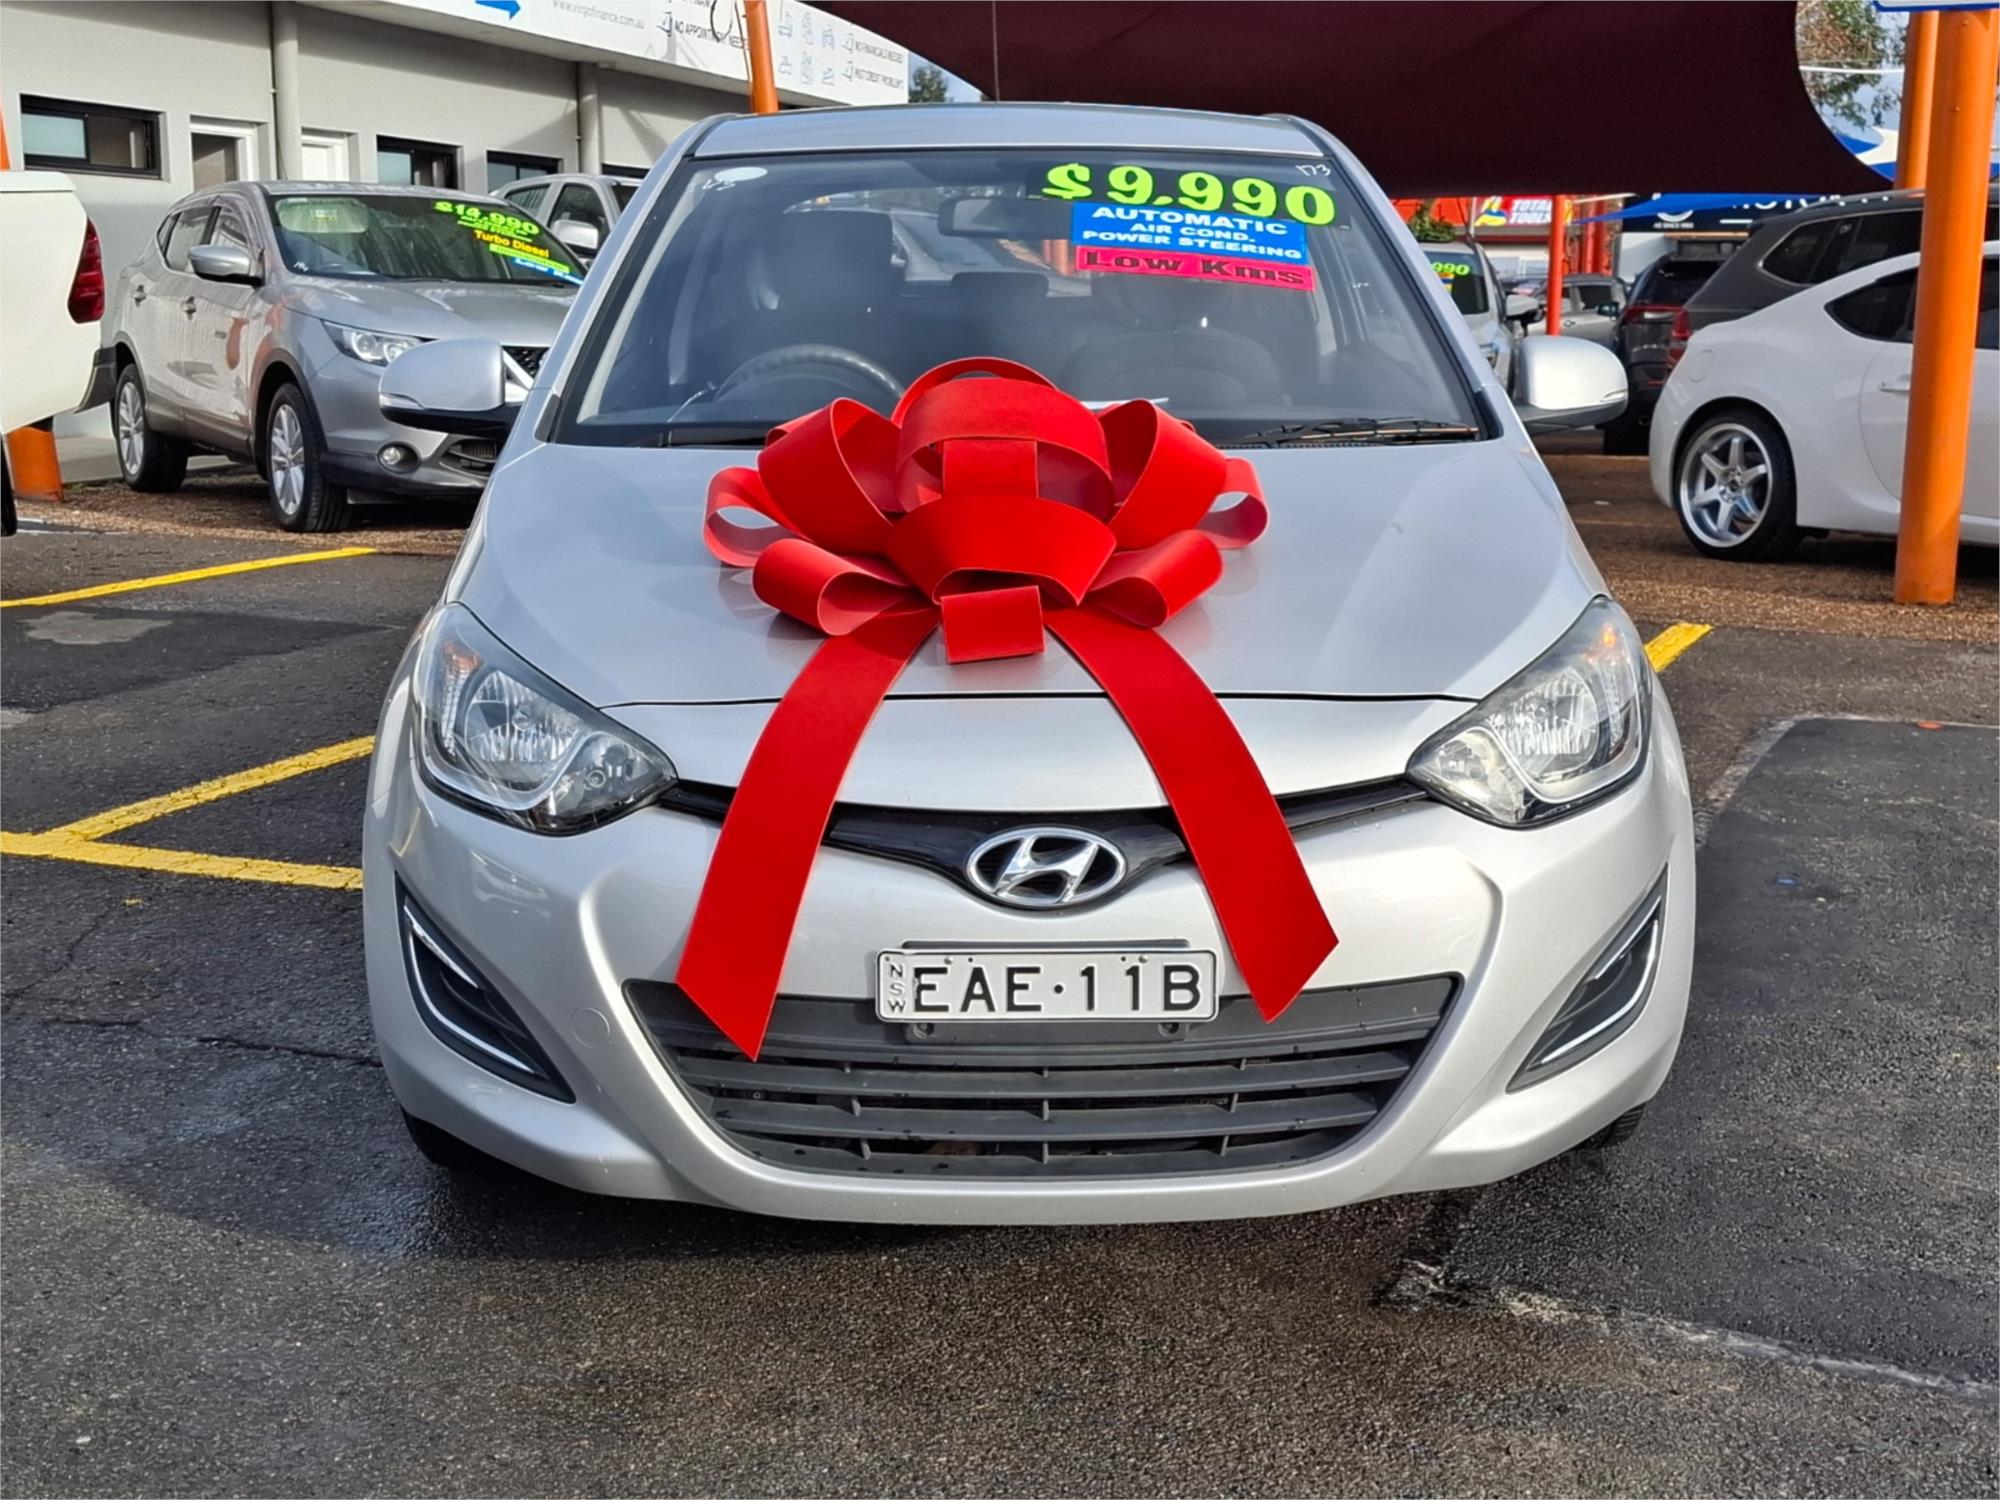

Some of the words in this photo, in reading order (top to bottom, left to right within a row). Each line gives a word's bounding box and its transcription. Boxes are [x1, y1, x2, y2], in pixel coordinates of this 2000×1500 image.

[685, 23, 728, 44] APPOINT
[1092, 206, 1288, 236] AUTOMATIC
[1131, 222, 1173, 235] AIR
[1180, 226, 1256, 243] COND.
[474, 229, 511, 247] Turbo
[512, 239, 550, 259] Diesel
[1082, 230, 1172, 246] POWER
[1178, 236, 1302, 260] STEERING
[1085, 251, 1182, 272] Low
[1201, 259, 1304, 285] Kms
[887, 963, 906, 1014] NSW
